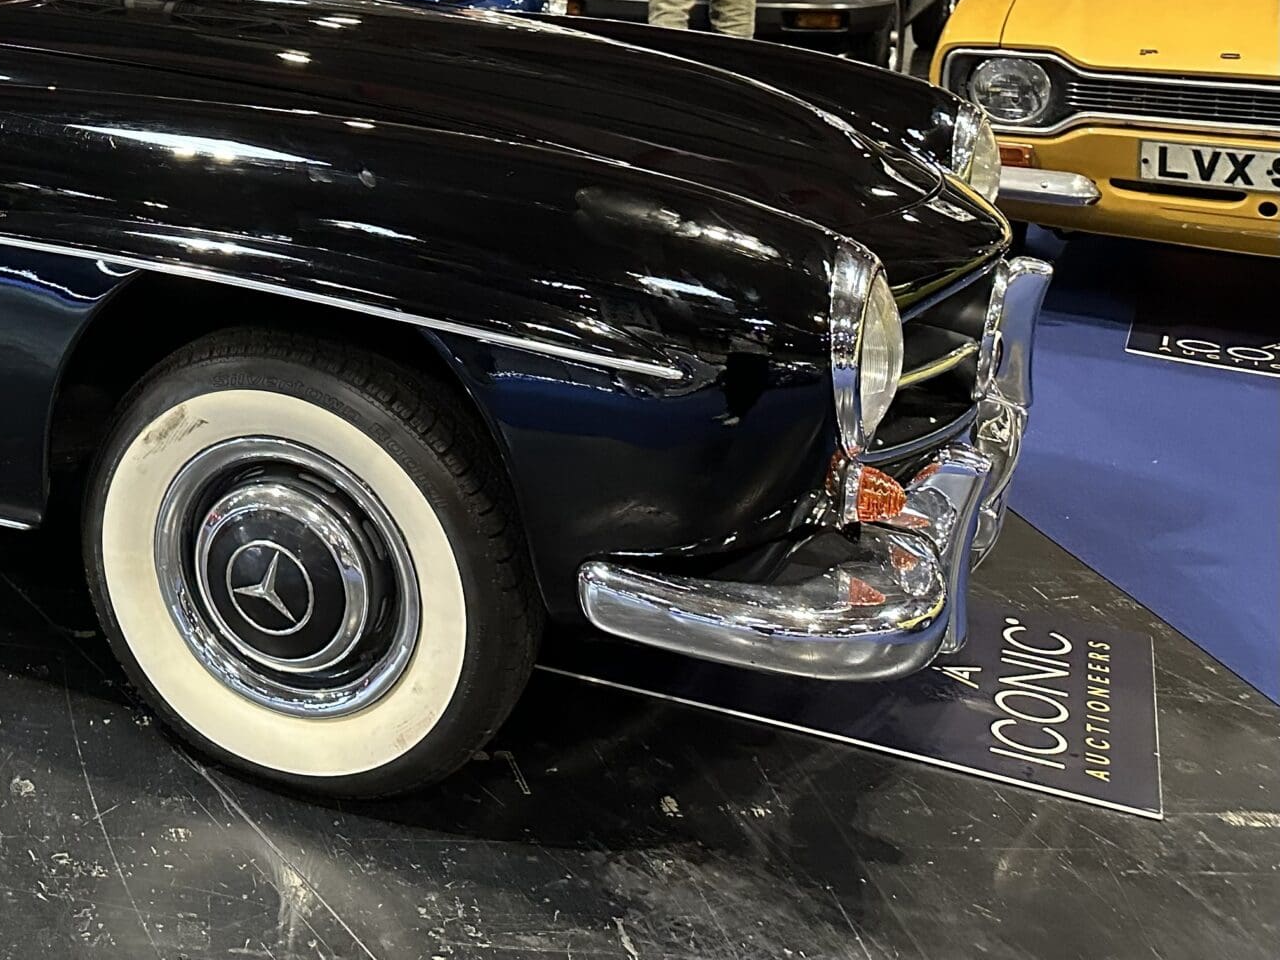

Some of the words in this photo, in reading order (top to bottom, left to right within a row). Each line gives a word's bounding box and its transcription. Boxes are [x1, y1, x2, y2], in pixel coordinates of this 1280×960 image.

[1158, 145, 1257, 186] LVX
[989, 625, 1073, 770] ICONIC
[1084, 640, 1112, 783] AUCTIONEERS
